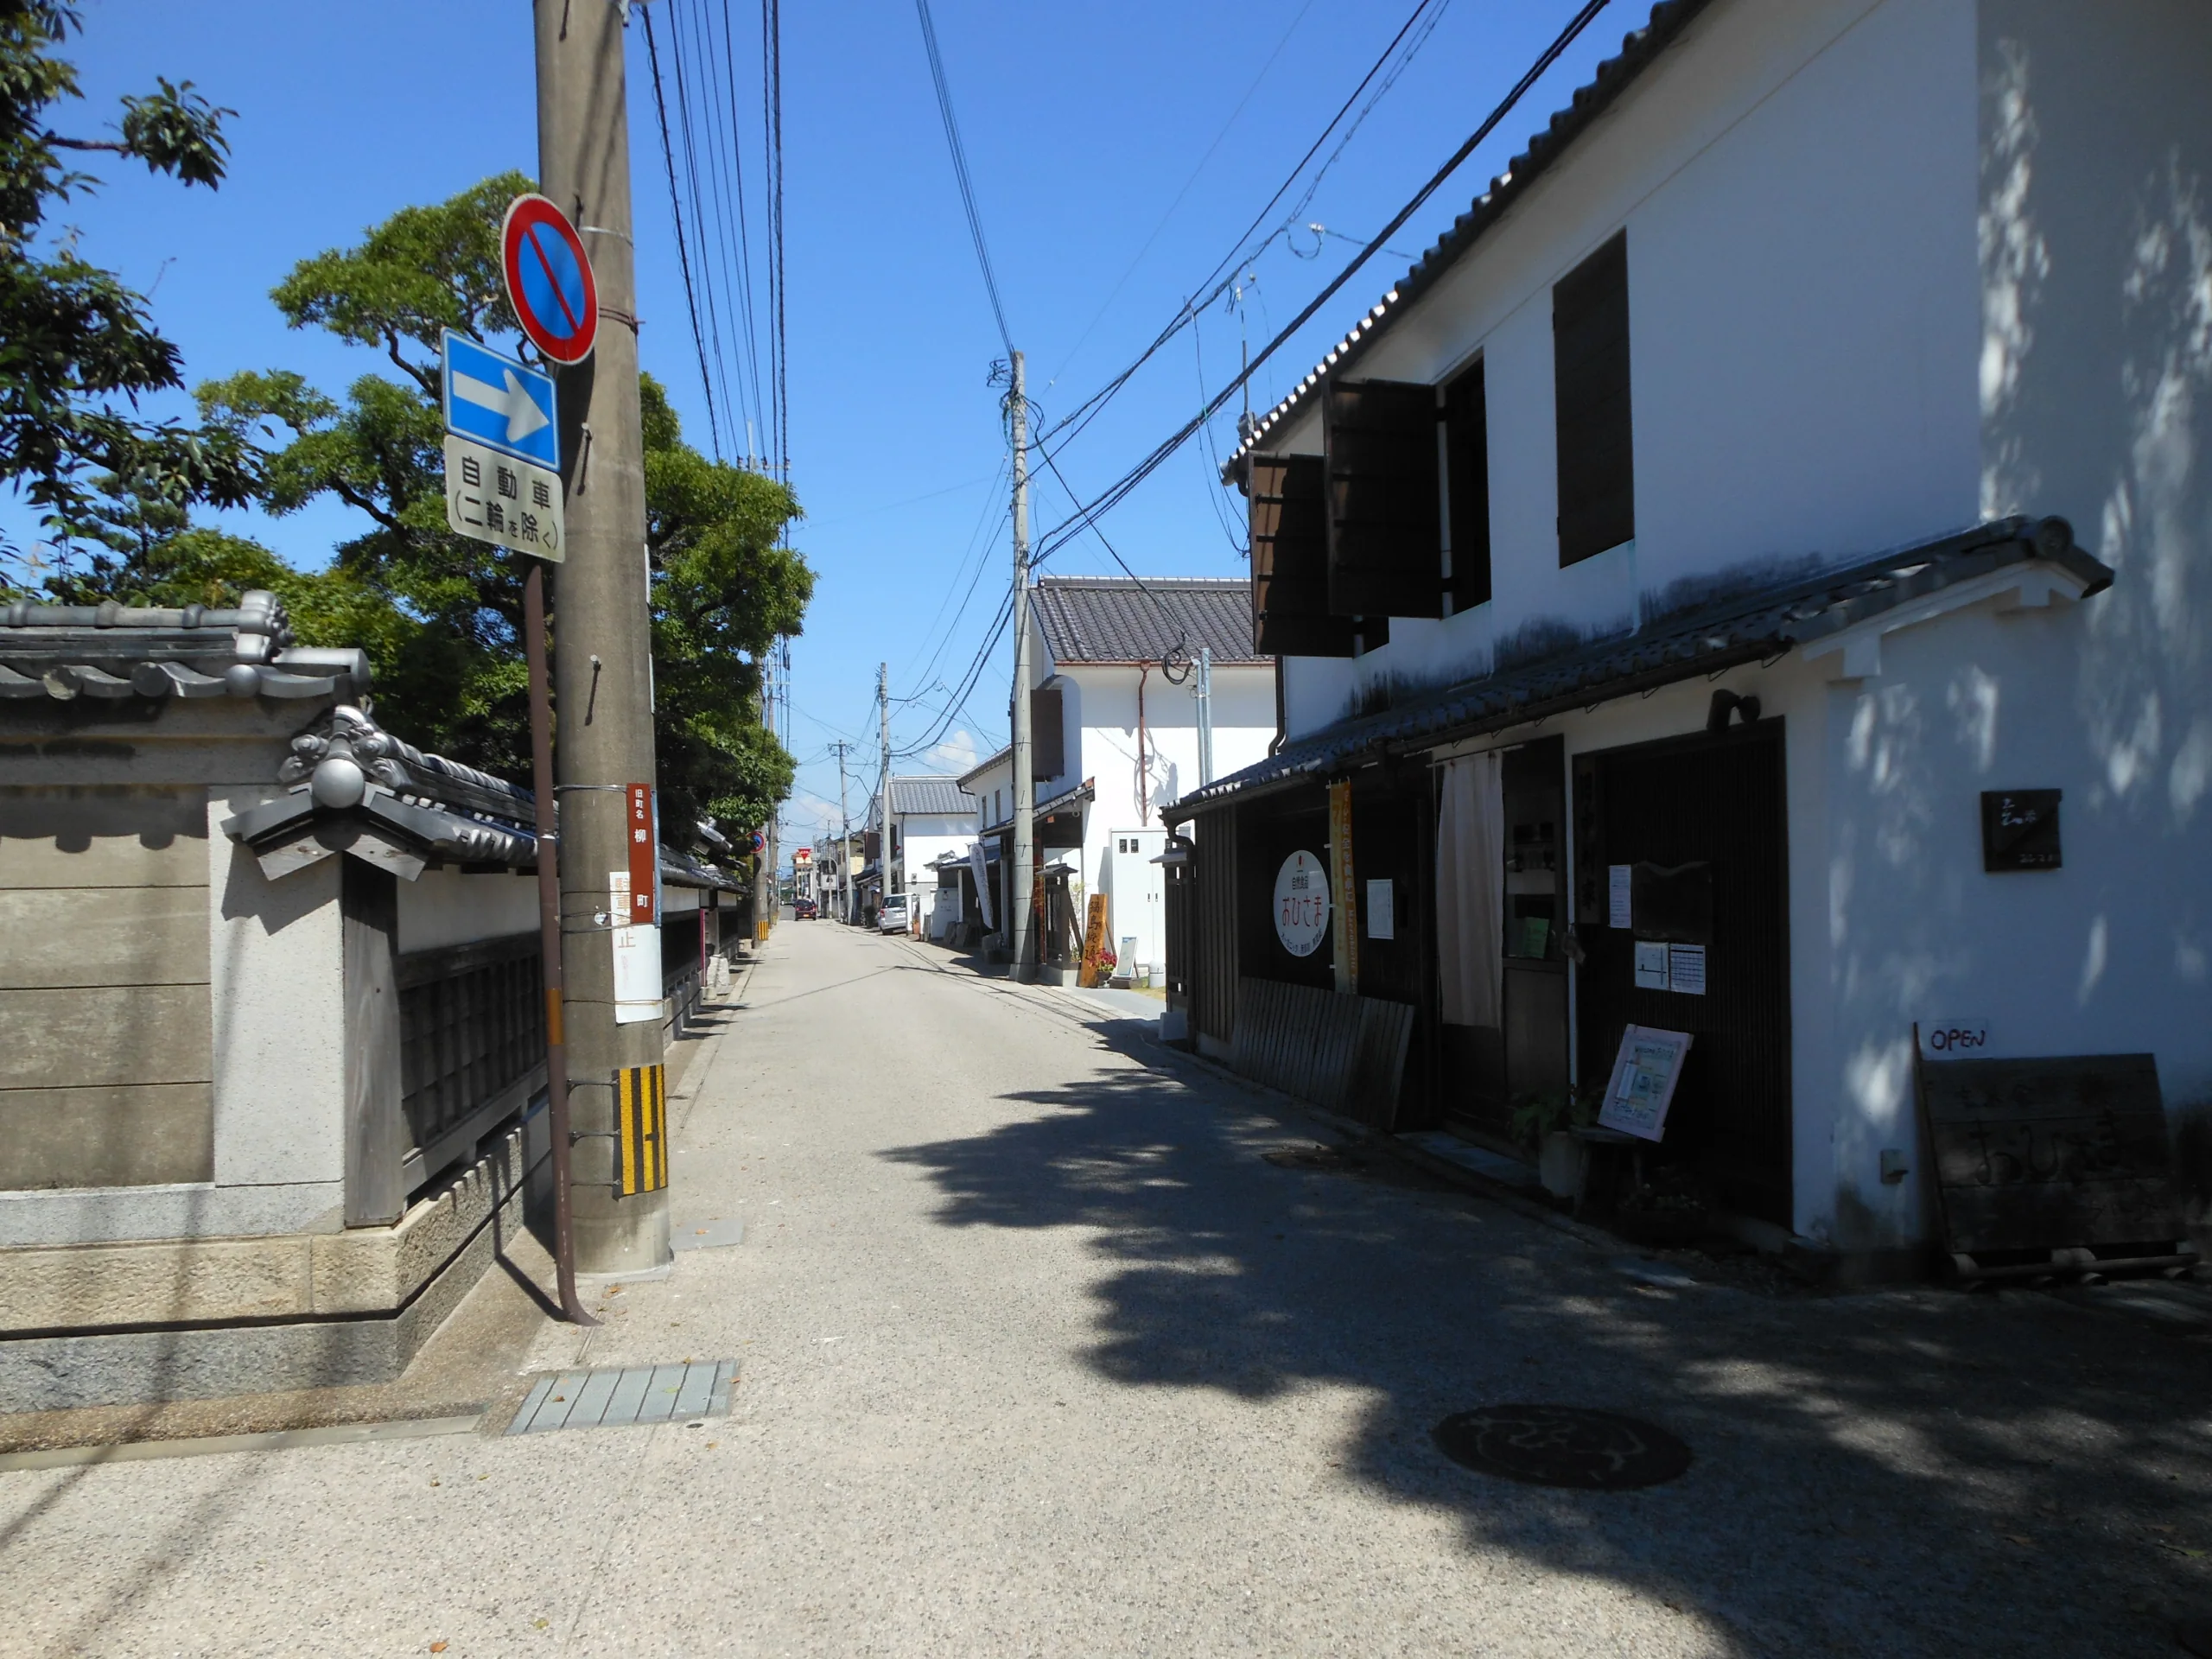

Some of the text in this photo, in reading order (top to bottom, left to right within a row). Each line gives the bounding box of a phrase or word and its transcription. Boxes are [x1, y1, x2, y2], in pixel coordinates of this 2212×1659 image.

[461, 455, 551, 510] 自動車
[634, 788, 644, 819] 旧町名
[1282, 895, 1322, 927] おひさま
[1931, 1028, 1986, 1052] OPEN
